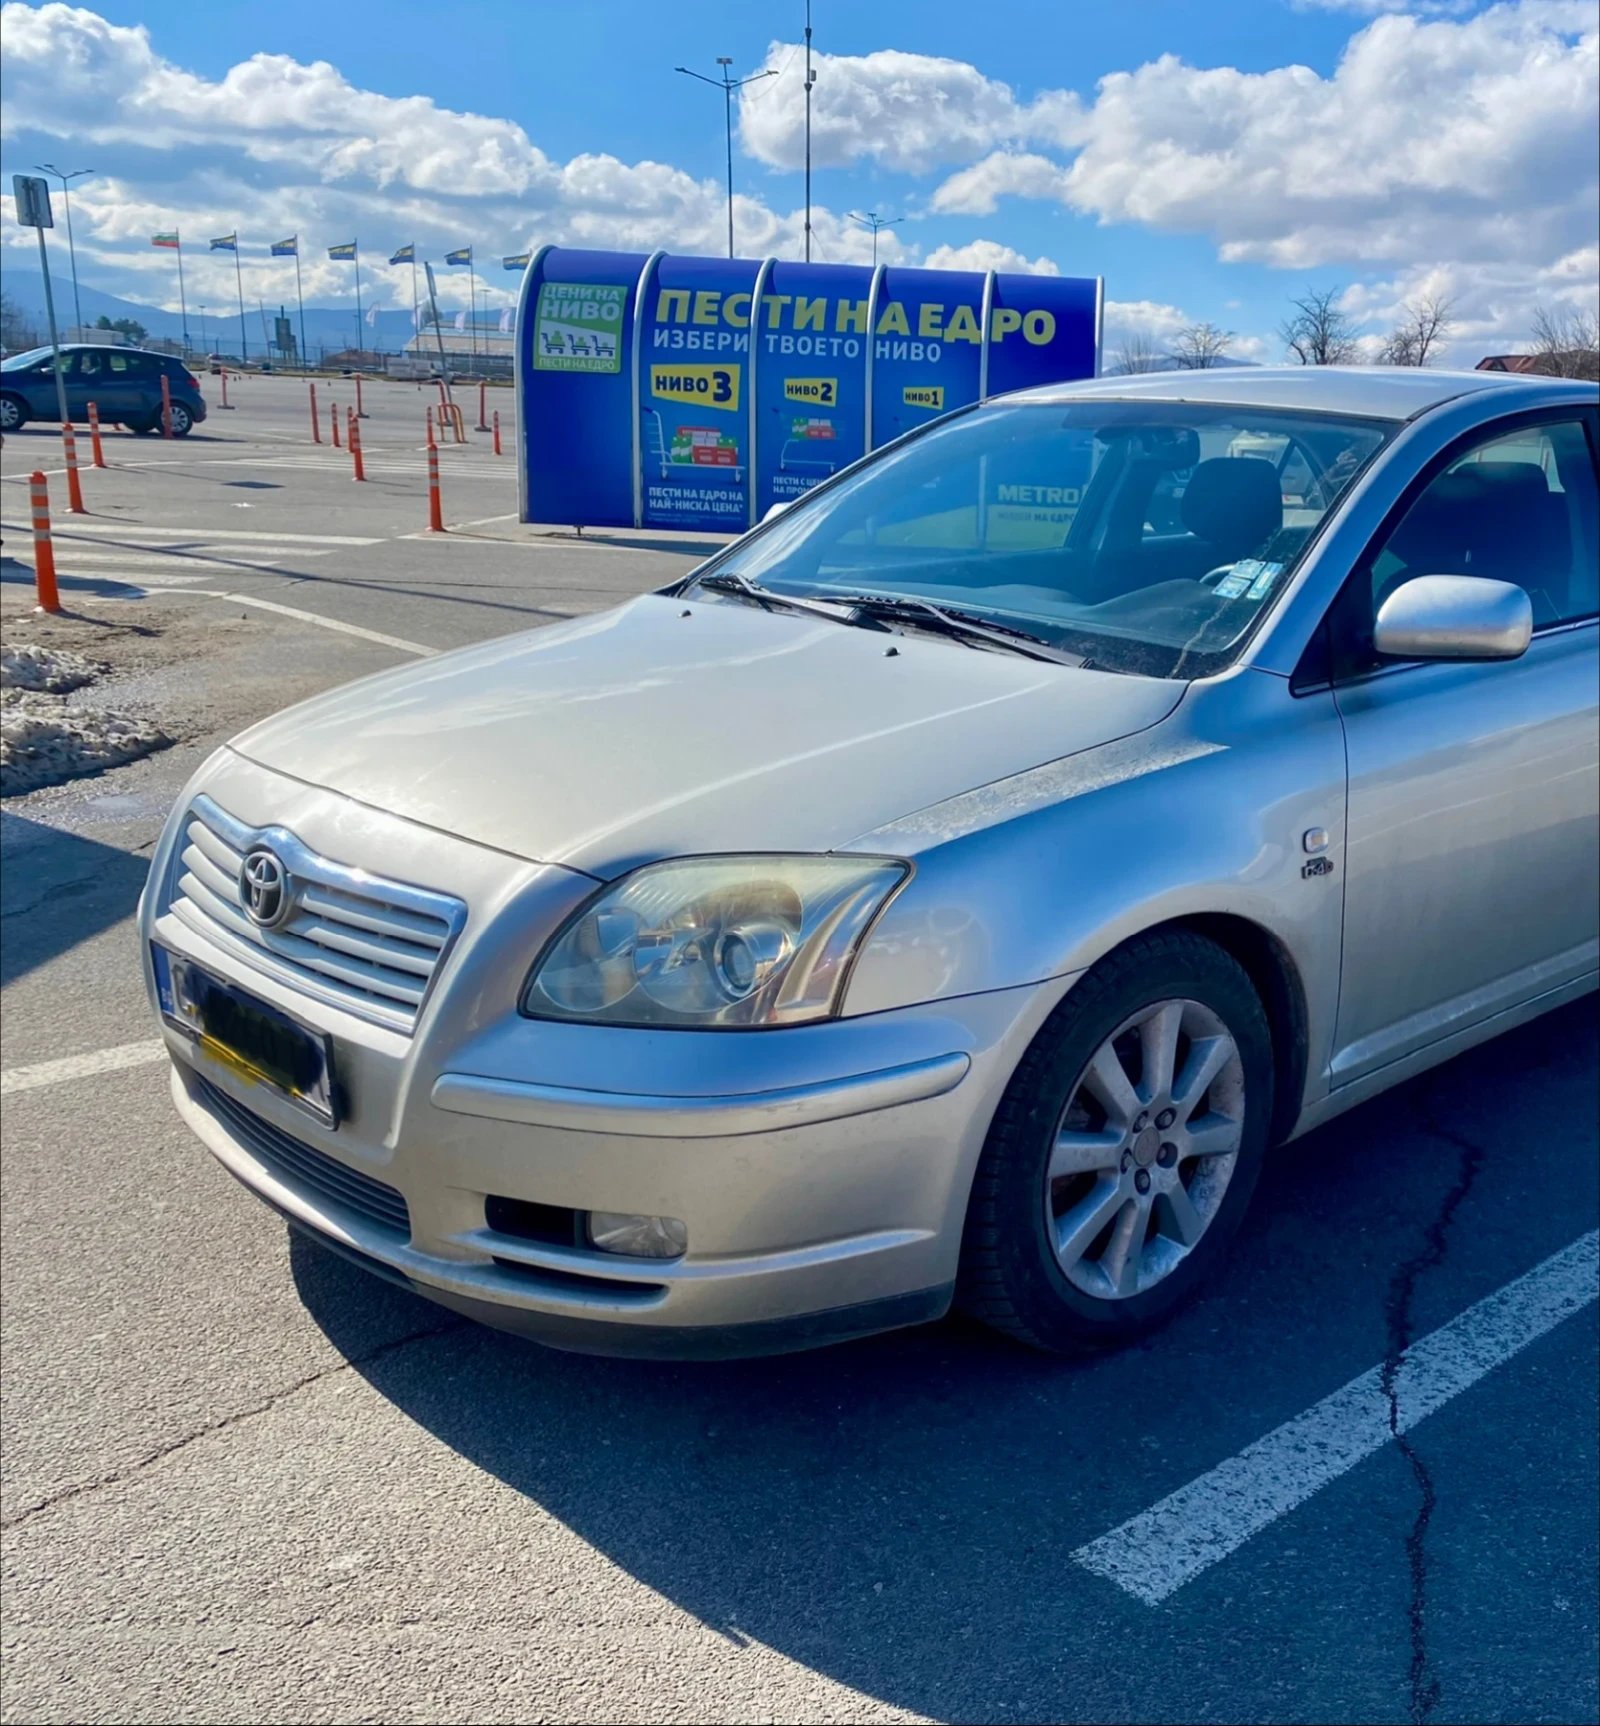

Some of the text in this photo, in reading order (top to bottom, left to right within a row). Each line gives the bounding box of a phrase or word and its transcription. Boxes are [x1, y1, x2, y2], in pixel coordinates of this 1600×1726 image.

[543, 286, 620, 301] ЦЕНИ НА
[541, 299, 621, 321] НИВО
[656, 288, 1056, 345] ПЕСТИ НА ЕДРО
[653, 328, 941, 362] ИЗБЕРИ ТВОЕТО НИВО
[539, 357, 615, 371] ПЕСТИ НА ЕДРО
[655, 370, 732, 403] НИВО 3
[786, 381, 833, 402] НИВО 2
[905, 390, 939, 406] НИВО 1
[773, 476, 799, 485] ПЕСТИ
[648, 487, 743, 501] ПЕСТИ НА ЕДРО НА
[773, 485, 785, 494] НА
[997, 484, 1079, 504] METRO
[648, 498, 710, 511] НАЙ-НИСКА
